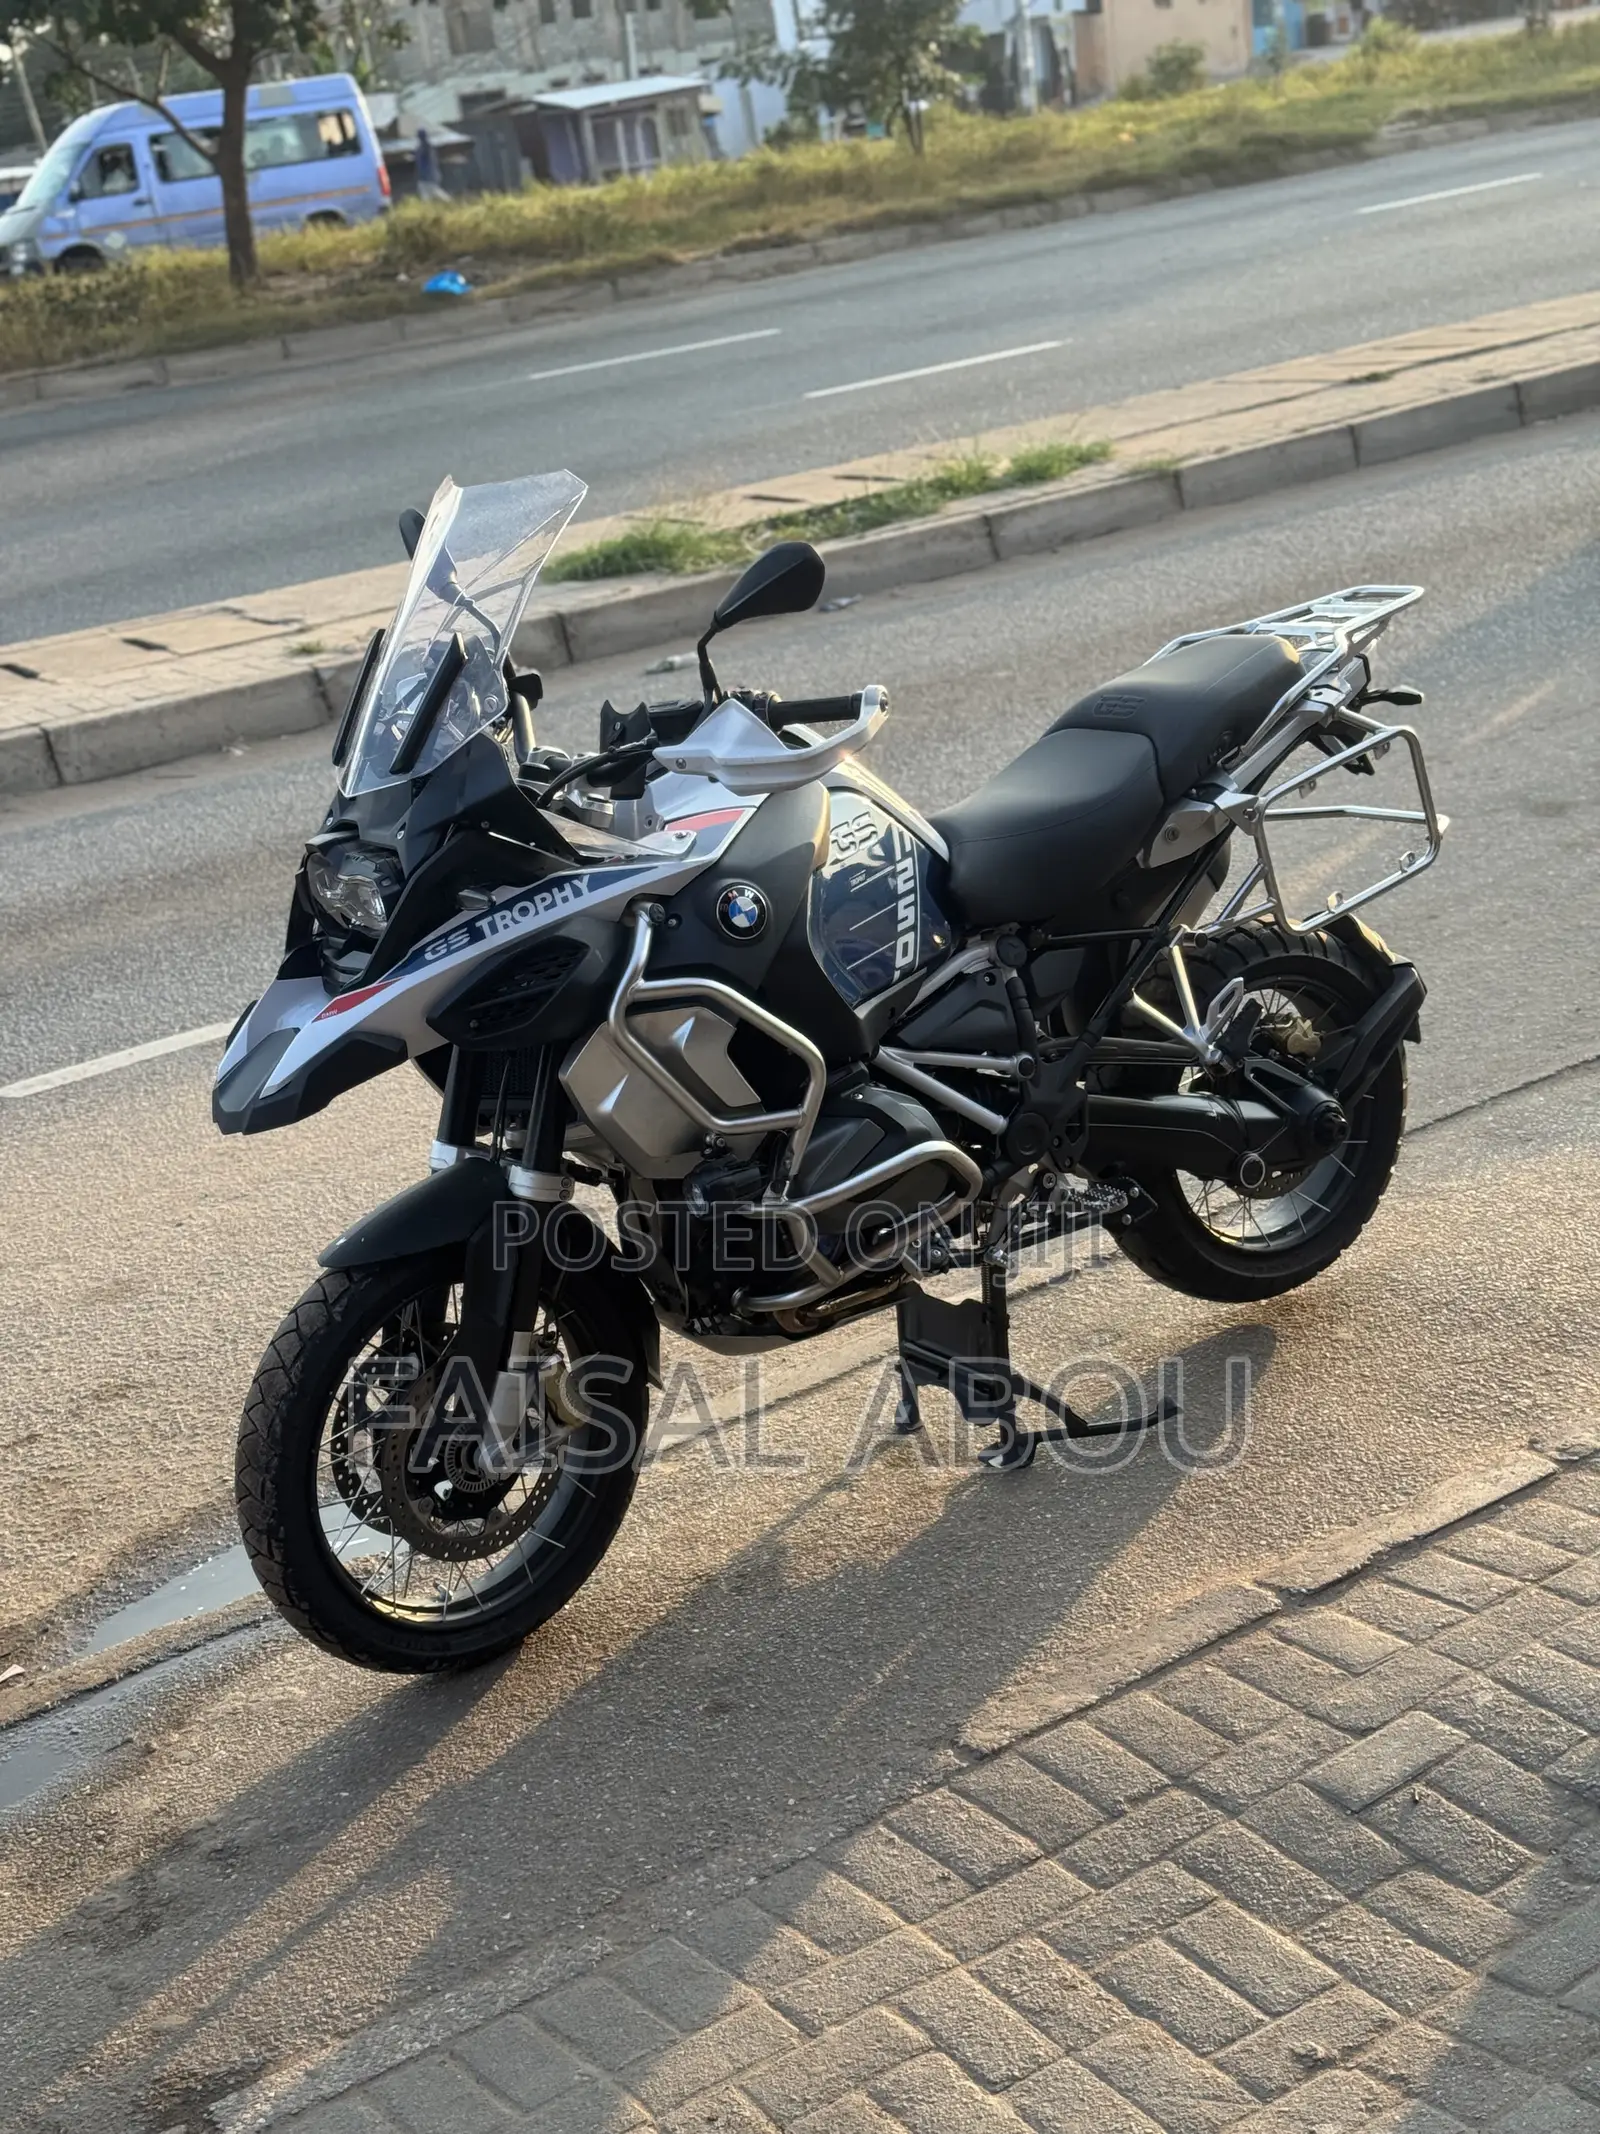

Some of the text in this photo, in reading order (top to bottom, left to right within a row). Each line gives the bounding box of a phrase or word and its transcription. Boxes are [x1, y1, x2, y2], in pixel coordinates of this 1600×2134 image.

[1093, 695, 1146, 719] GS
[829, 810, 878, 861] GS
[424, 874, 591, 961] GS TROPHY
